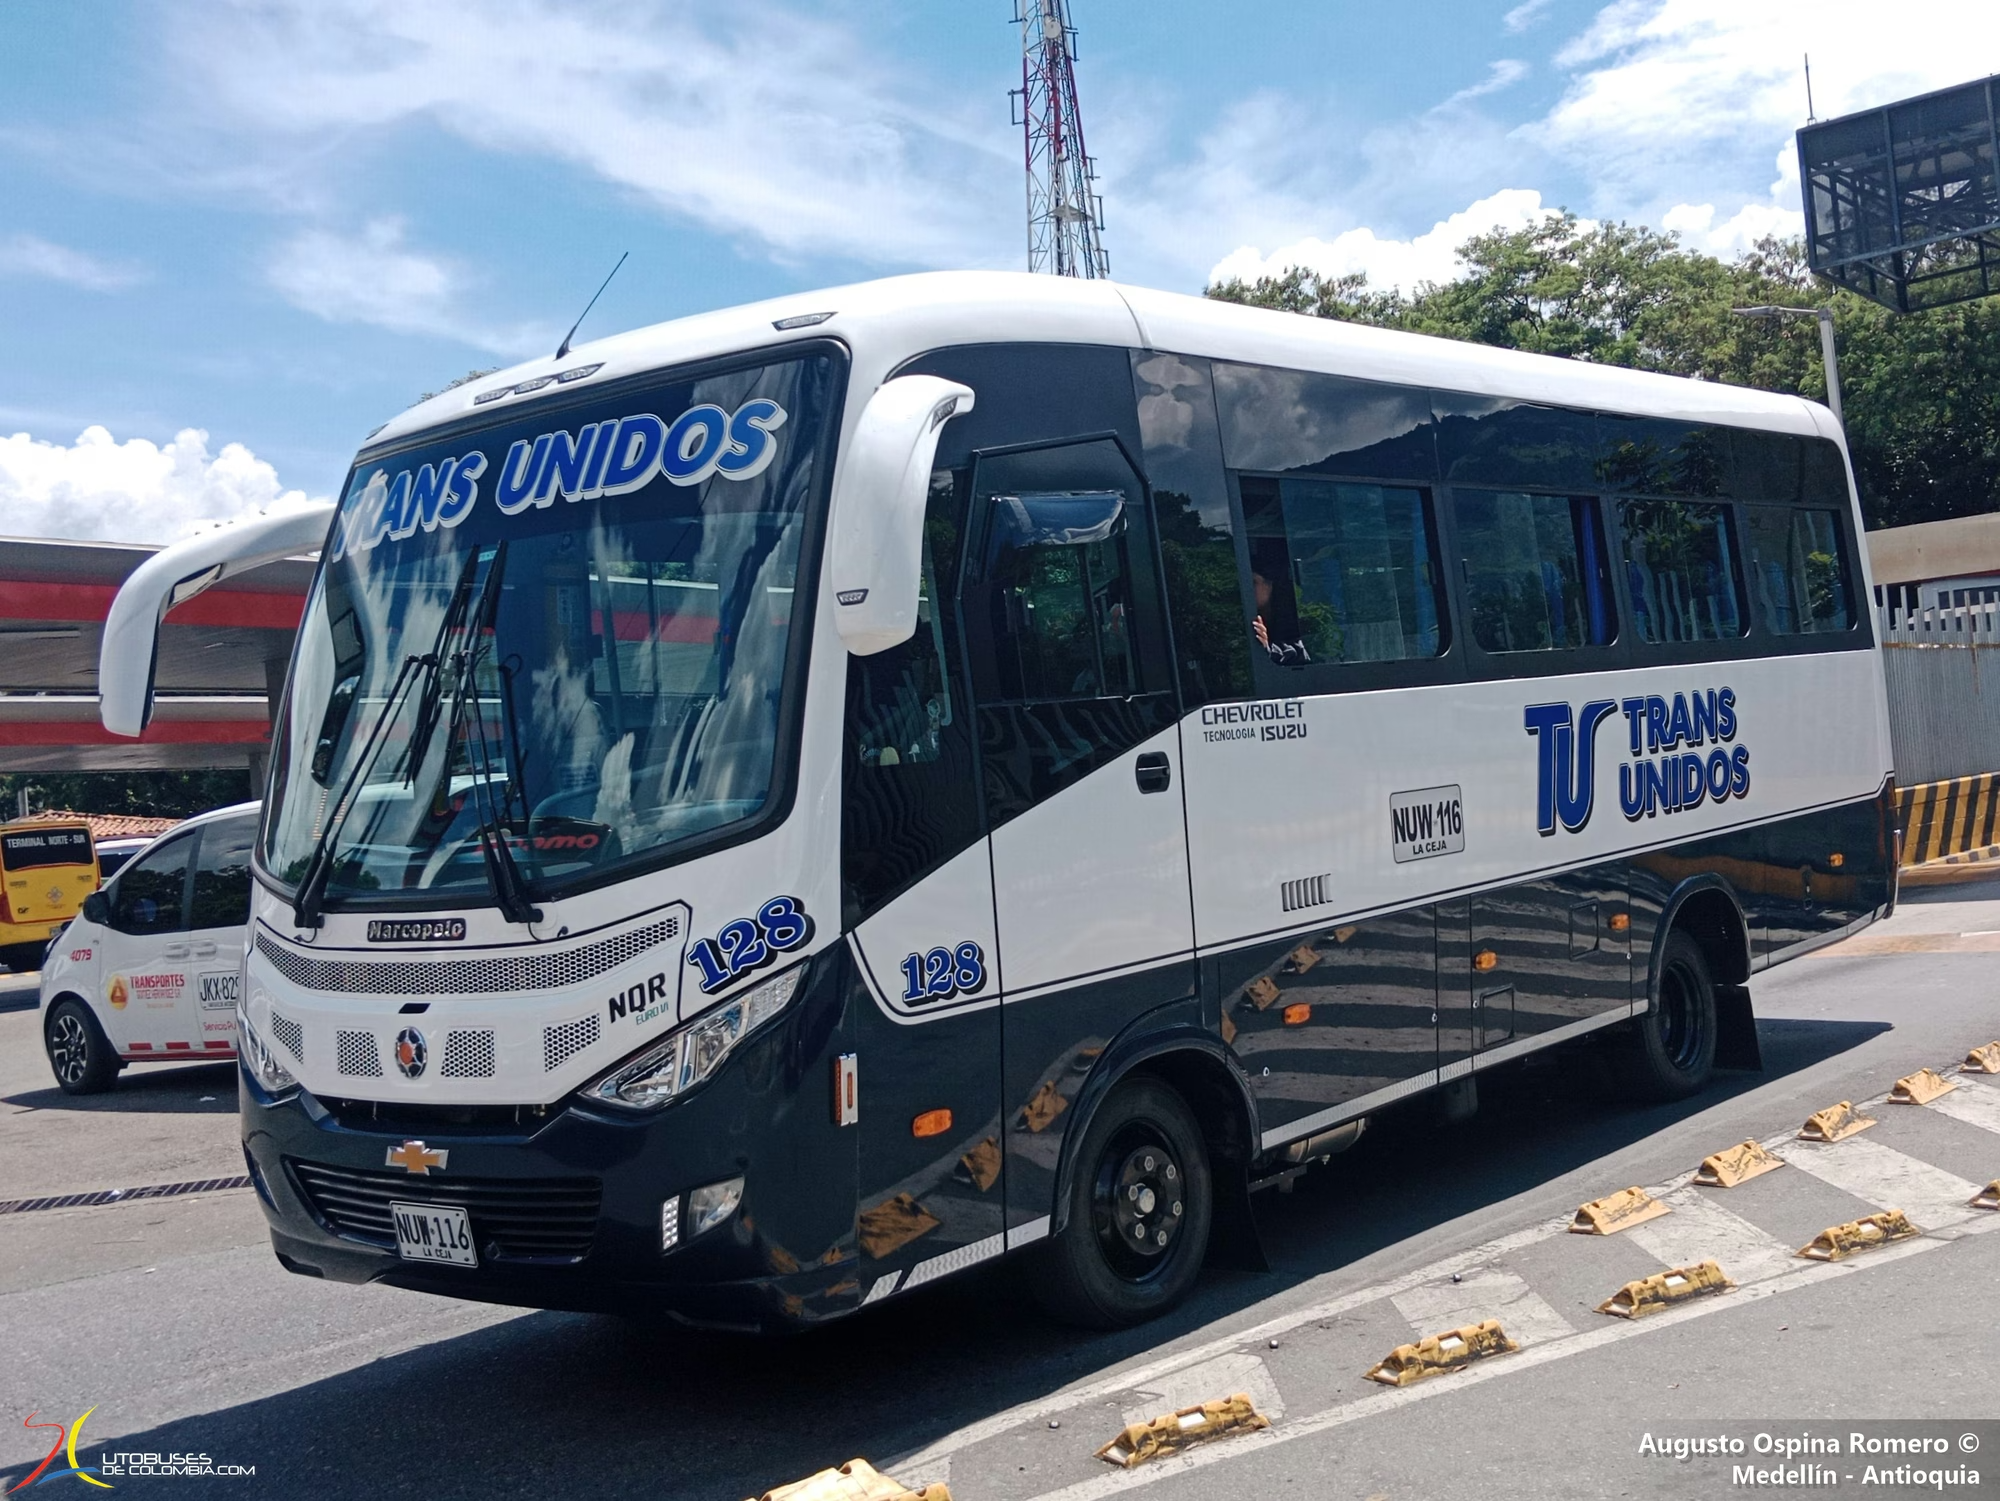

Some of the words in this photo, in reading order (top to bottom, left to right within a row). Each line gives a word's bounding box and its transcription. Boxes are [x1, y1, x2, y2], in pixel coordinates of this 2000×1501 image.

[495, 399, 788, 516] UNIDOS
[1202, 702, 1304, 725] CHEVROLET
[1622, 686, 1736, 756] TRANS
[1203, 727, 1256, 743] TECNOLOGIA
[1261, 723, 1307, 741] ISUZU
[1619, 744, 1749, 822] UNIDOS
[7, 836, 46, 848] TERMINAL
[48, 835, 68, 845] NORTE
[73, 834, 85, 844] SUR
[1412, 844, 1424, 855] LA
[1425, 840, 1447, 853] CEJA
[368, 920, 464, 940] Marcopolo
[70, 948, 92, 962] 4079
[686, 895, 816, 995] 128
[130, 974, 185, 989] TRANSPORTES
[901, 940, 987, 1008] 128
[609, 972, 667, 1024] NQR
[636, 1006, 659, 1025] EURO
[422, 1247, 432, 1257] LA
